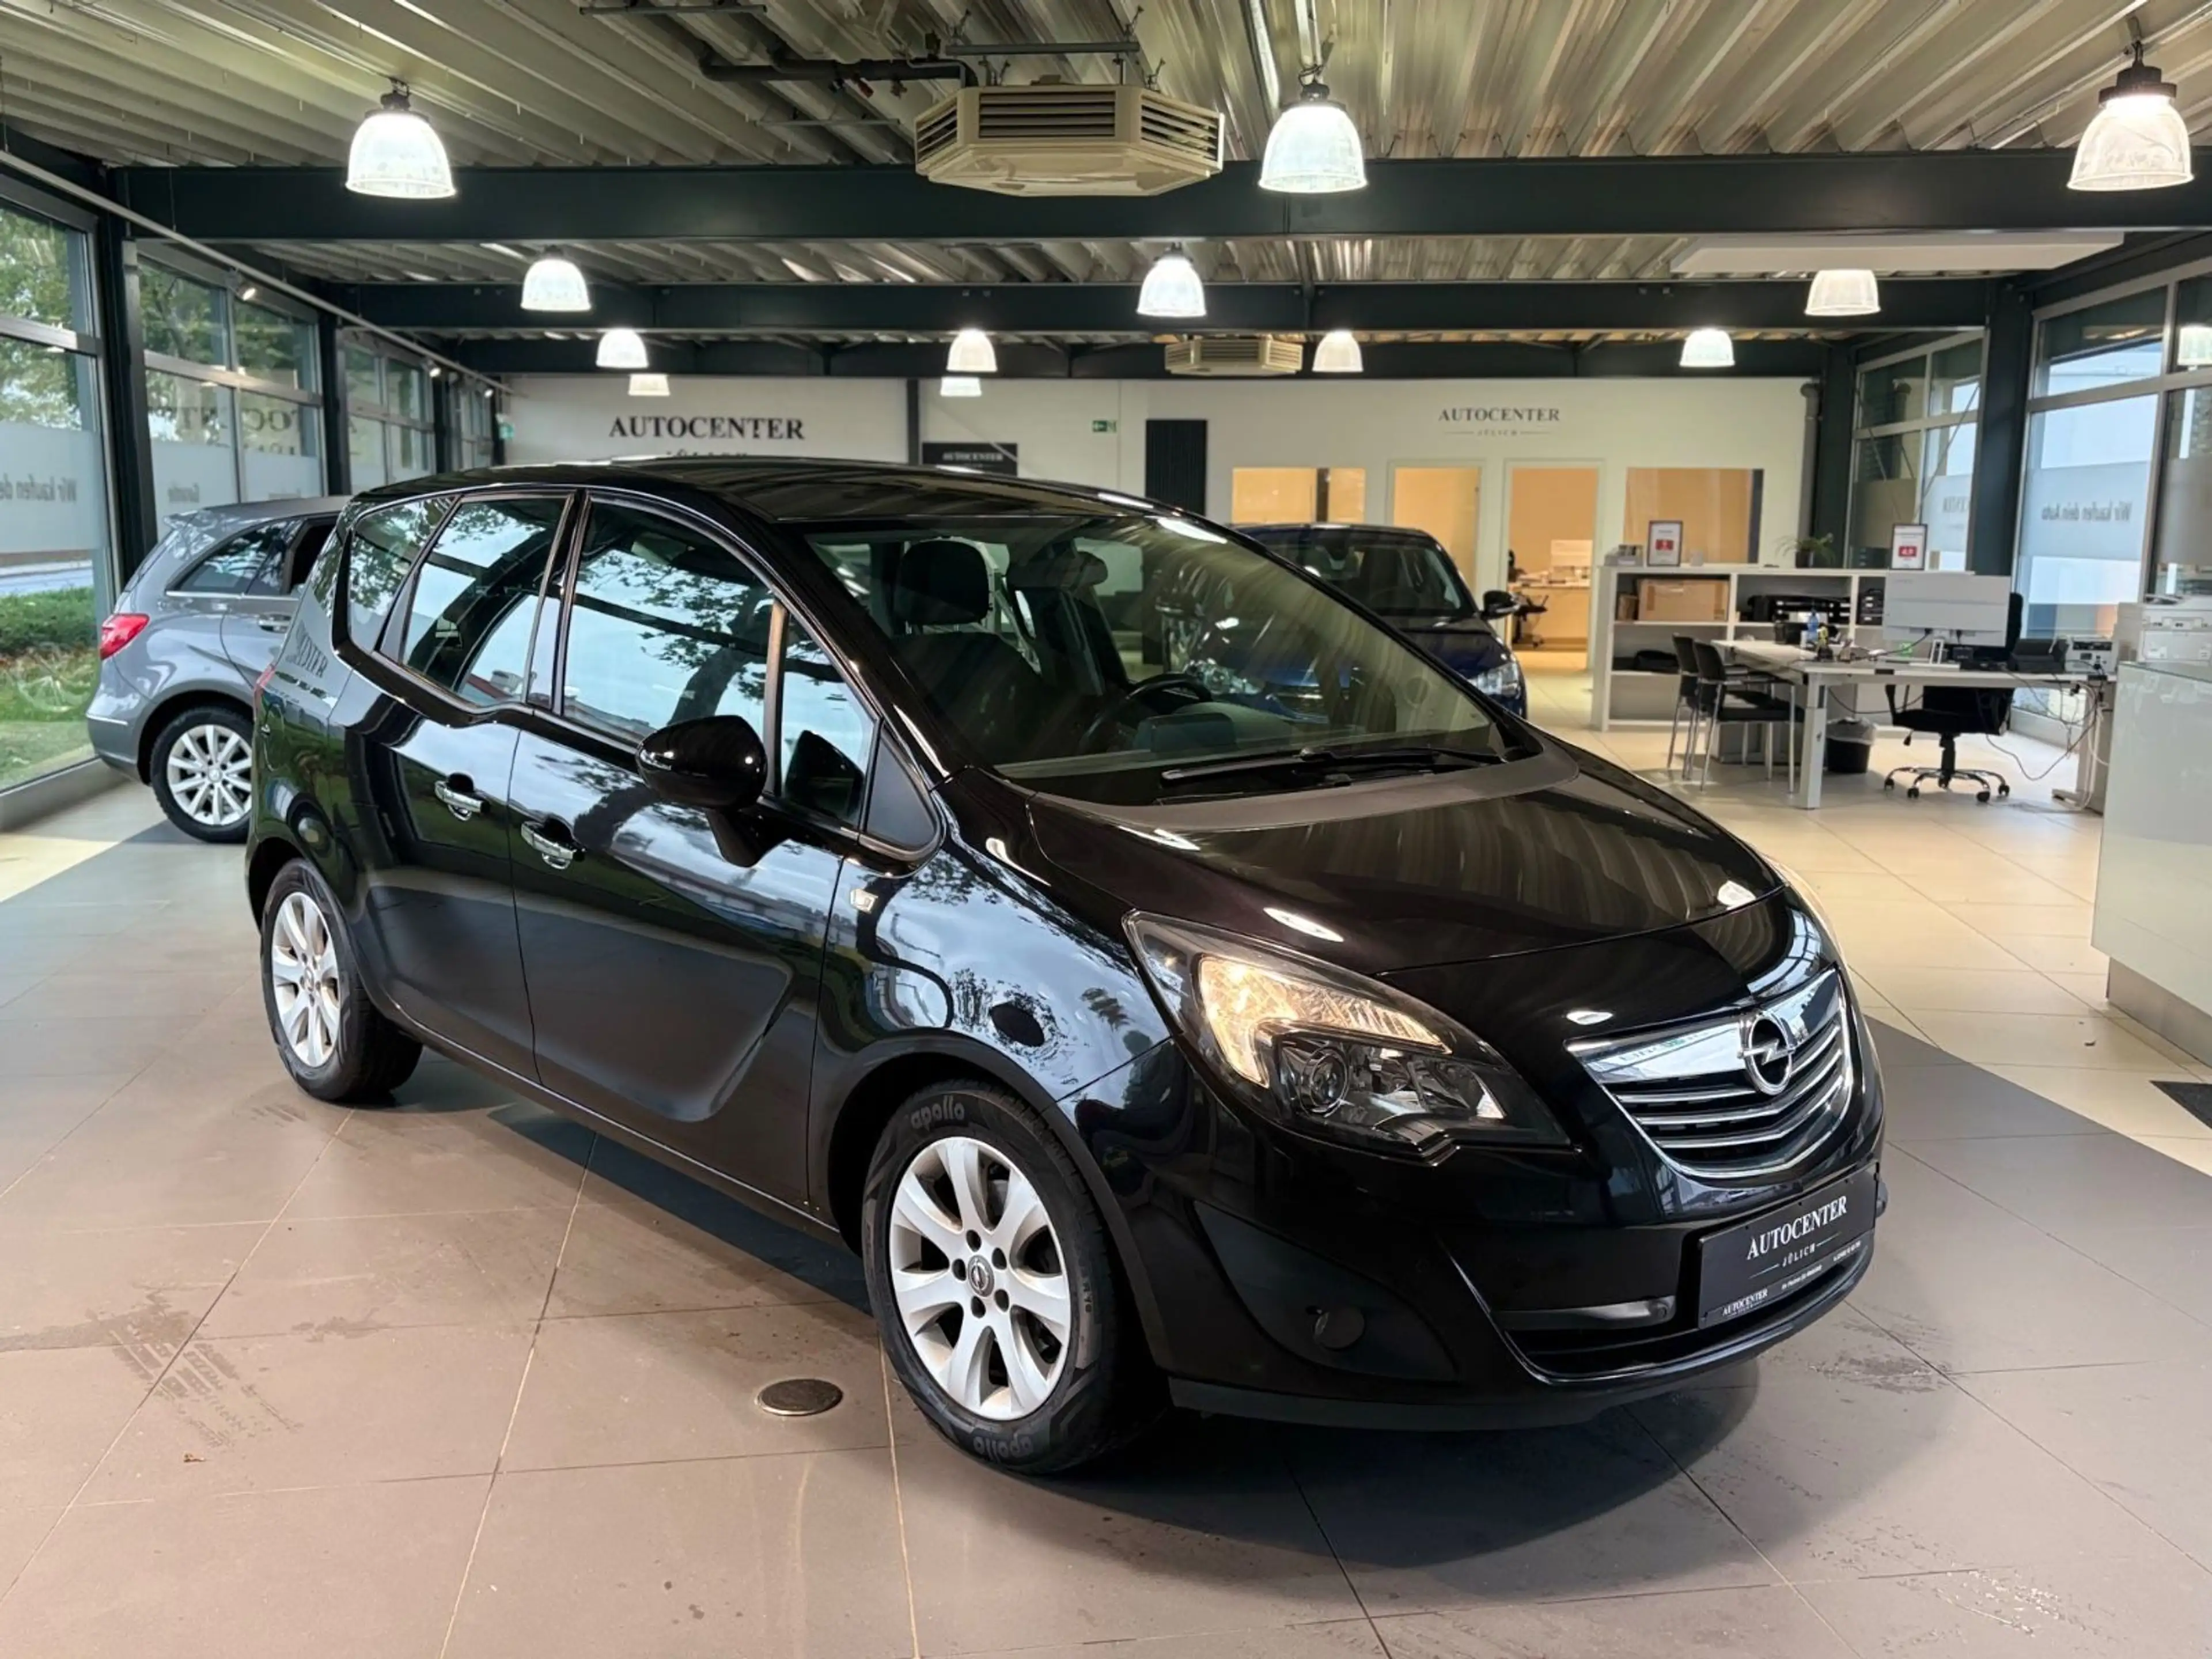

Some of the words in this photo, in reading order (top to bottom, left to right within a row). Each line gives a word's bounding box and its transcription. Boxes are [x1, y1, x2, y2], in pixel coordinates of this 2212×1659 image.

[608, 415, 805, 440] AUTOCENTER
[1438, 407, 1560, 422] AUTOCENTER
[911, 1095, 964, 1131] apollo
[1745, 1195, 1847, 1260] AUTOCENTER
[1722, 1288, 1768, 1316] AUTOCENTER
[973, 1433, 1034, 1464] apollo
